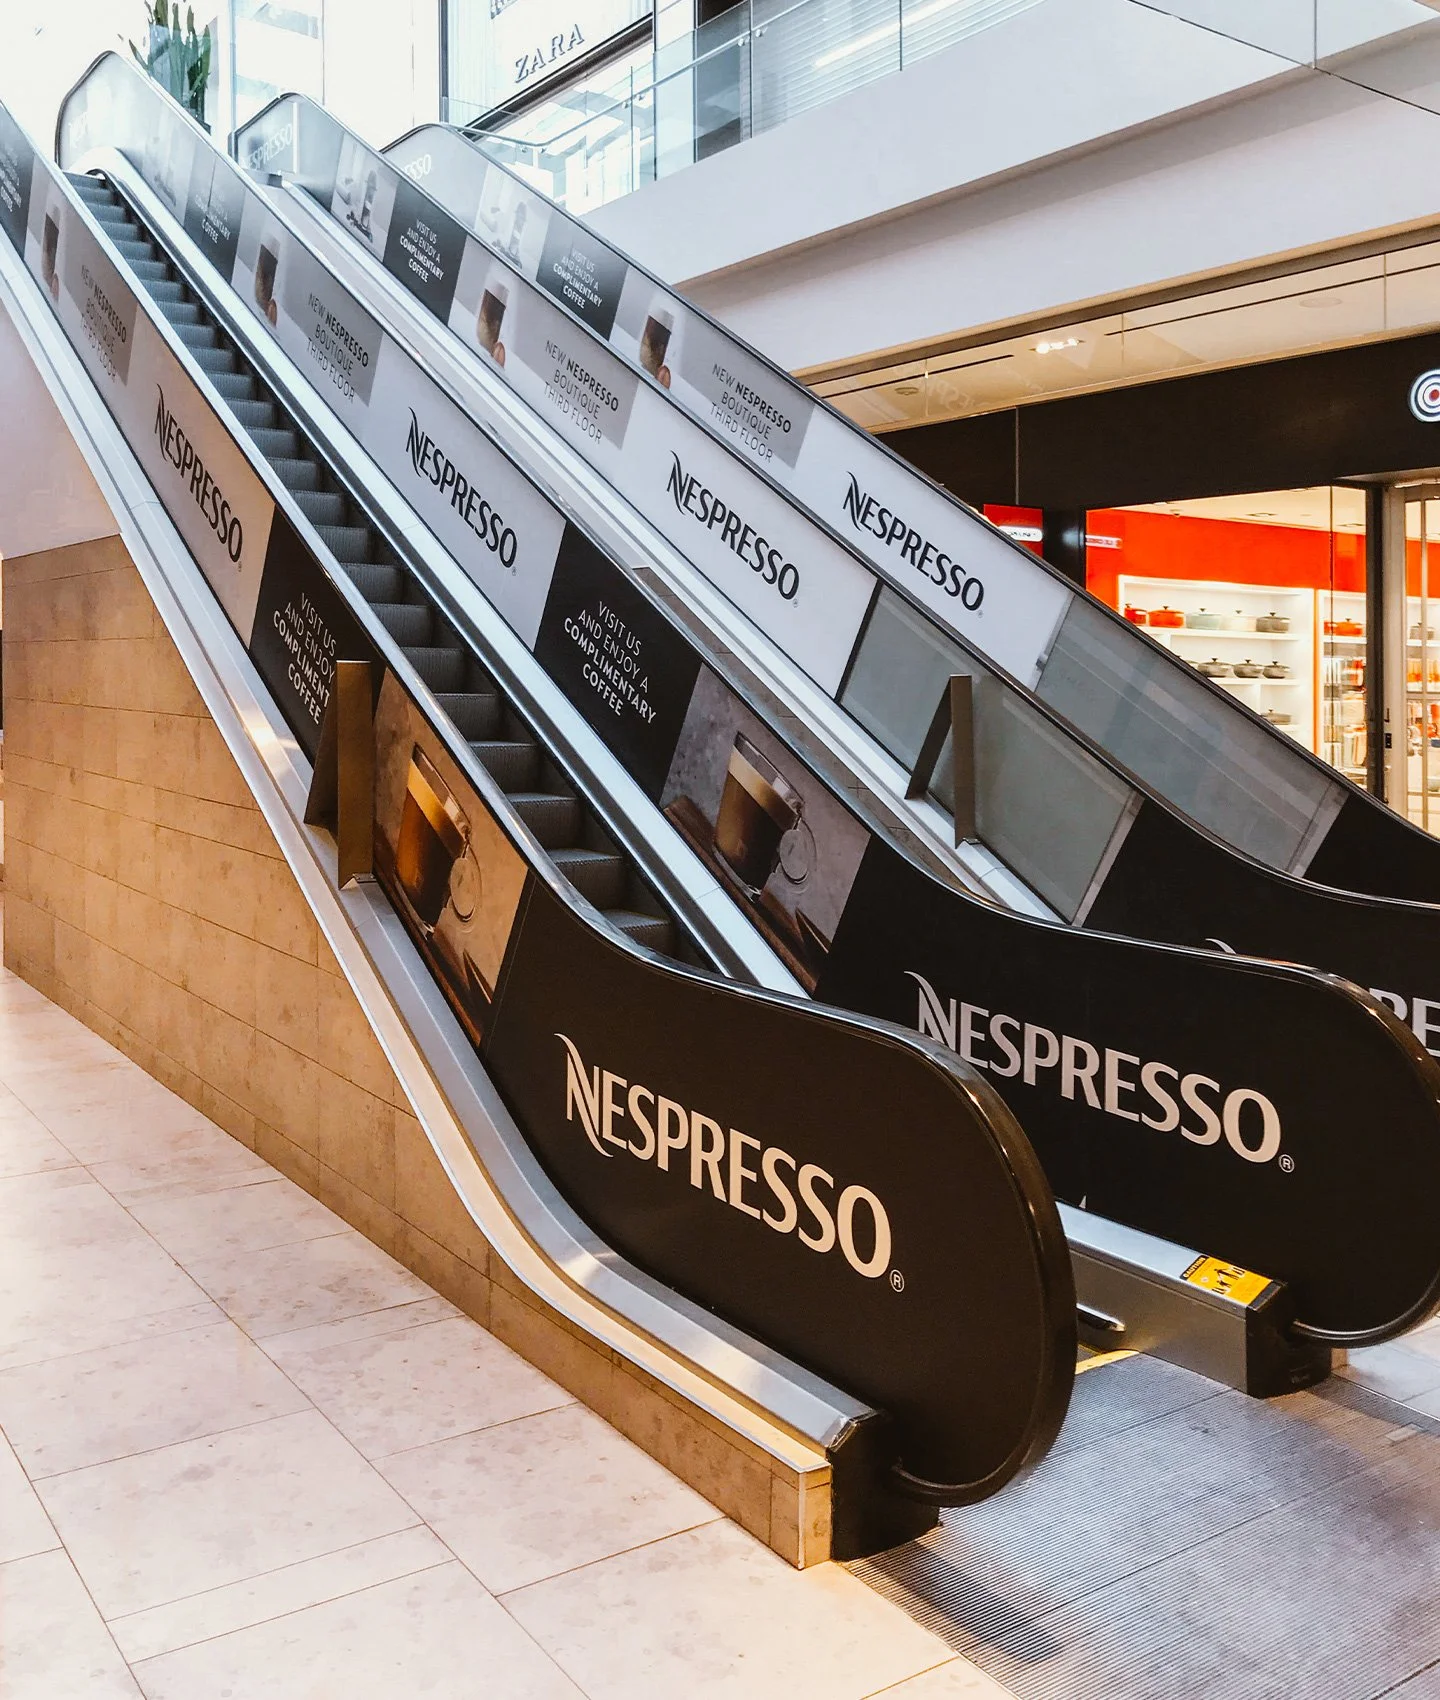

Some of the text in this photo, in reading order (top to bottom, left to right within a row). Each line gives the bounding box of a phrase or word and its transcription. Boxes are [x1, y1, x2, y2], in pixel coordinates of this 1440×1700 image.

[515, 23, 585, 83] ZARA
[400, 235, 444, 281] COMPLIMENTARY
[407, 227, 440, 263] AND ENJOY A
[416, 219, 437, 244] VISIT US
[572, 249, 594, 273] VISIT US
[409, 258, 429, 283] COFFEE
[553, 263, 602, 307] COMPLIMENTARY
[562, 256, 599, 292] AND ENJOY A
[563, 285, 585, 309] COFFEE
[308, 293, 369, 368] NEW NESPRESSO
[315, 323, 354, 376] BOUTIQUE
[307, 337, 354, 404] THIRD FLOOR
[545, 340, 619, 412] NEW NESPRESSO
[554, 369, 601, 420] BOUTIQUE
[712, 363, 792, 434] NEW NESPRESSO
[544, 381, 602, 445] THIRD FLOOR
[711, 402, 773, 463] THIRD FLOOR
[721, 391, 771, 441] BOUTIQUE
[154, 383, 243, 563] NESPRESSO
[405, 406, 518, 569] NESPRESSO
[666, 449, 800, 600] NESPRESSO
[842, 470, 985, 612] NESPRESSO
[284, 602, 335, 684] AND ENJOY
[301, 592, 337, 657] VISIT US
[578, 609, 648, 694] AND ENJOY A
[599, 600, 642, 656] VISIT US
[273, 610, 330, 708] COMPLIMENT
[564, 617, 657, 724] COMPLIMENTARY
[582, 663, 624, 717] COFFEE
[288, 663, 321, 725] COFFEE
[903, 970, 1281, 1163] NESPRESSO
[554, 1032, 892, 1279] NESPRESSO
